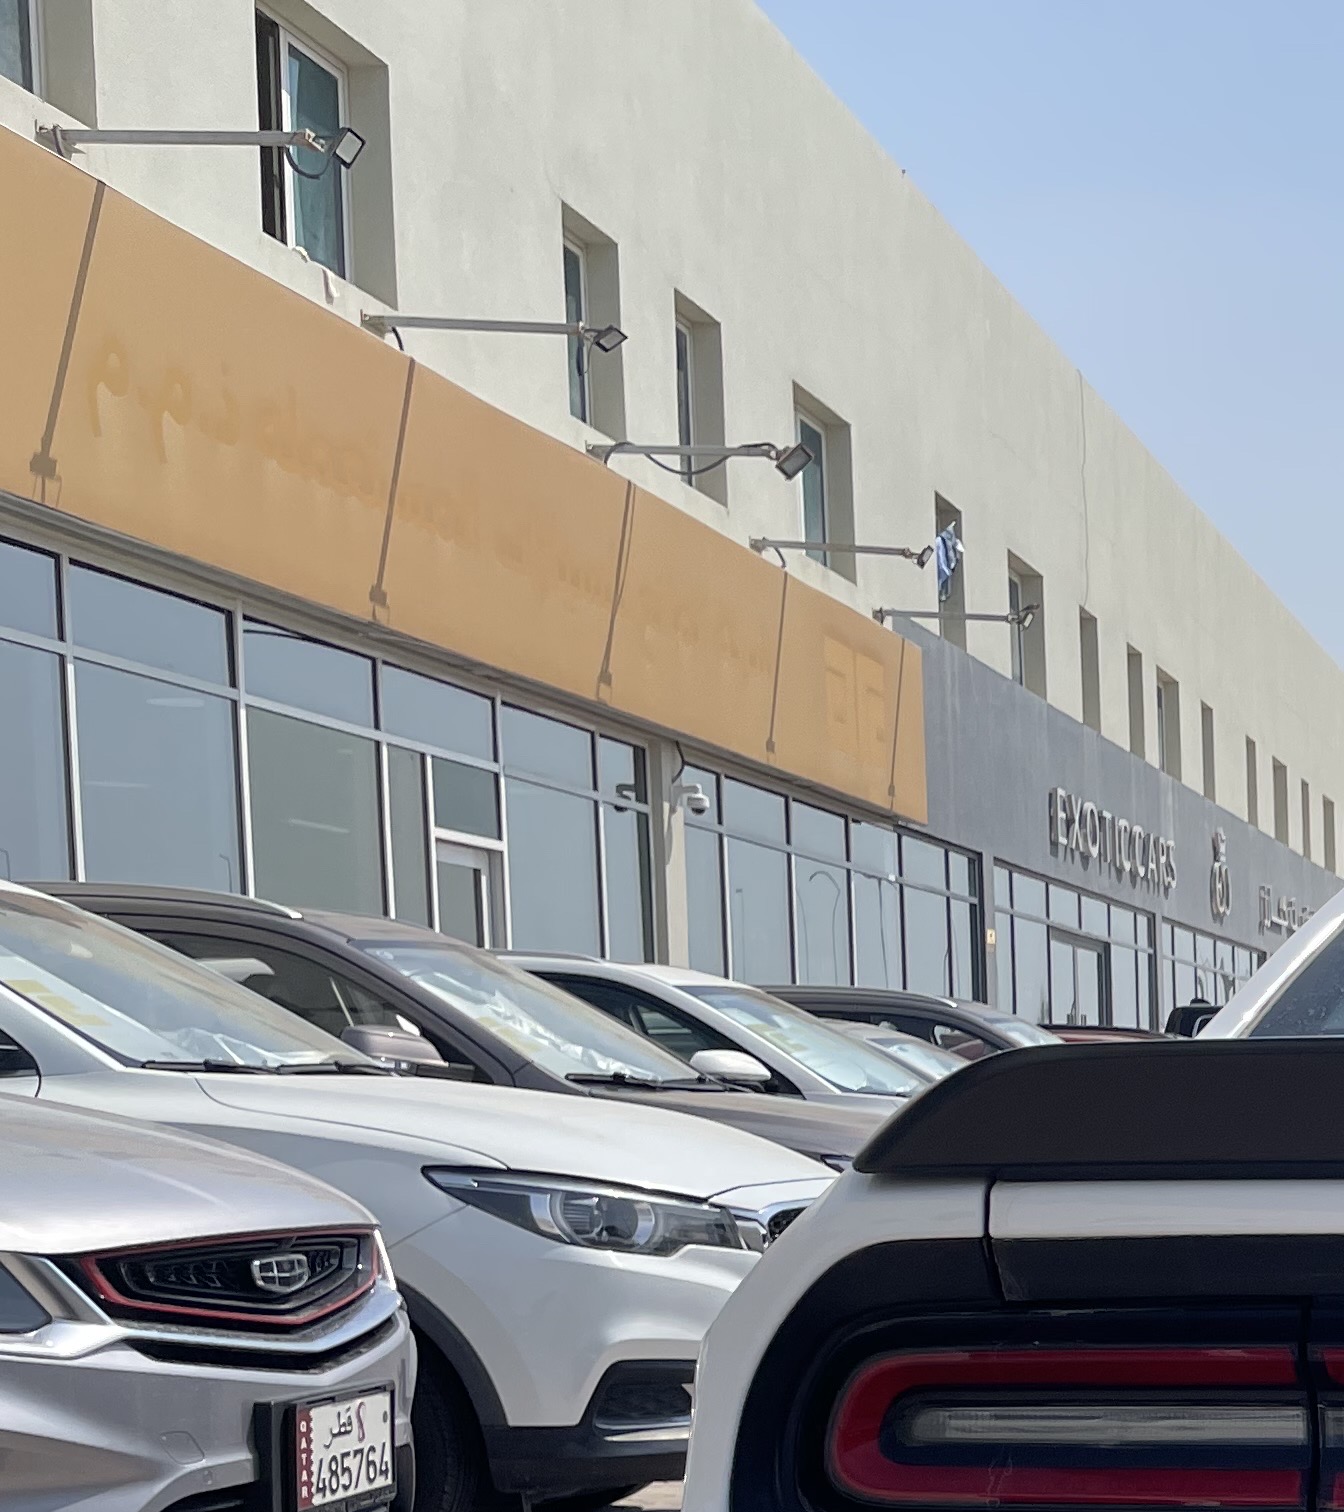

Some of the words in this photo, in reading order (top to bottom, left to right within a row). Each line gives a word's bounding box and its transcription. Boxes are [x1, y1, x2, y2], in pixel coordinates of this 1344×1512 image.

[323, 1406, 353, 1449] قطر
[300, 1421, 308, 1498] QATAR
[316, 1442, 389, 1498] 485764
